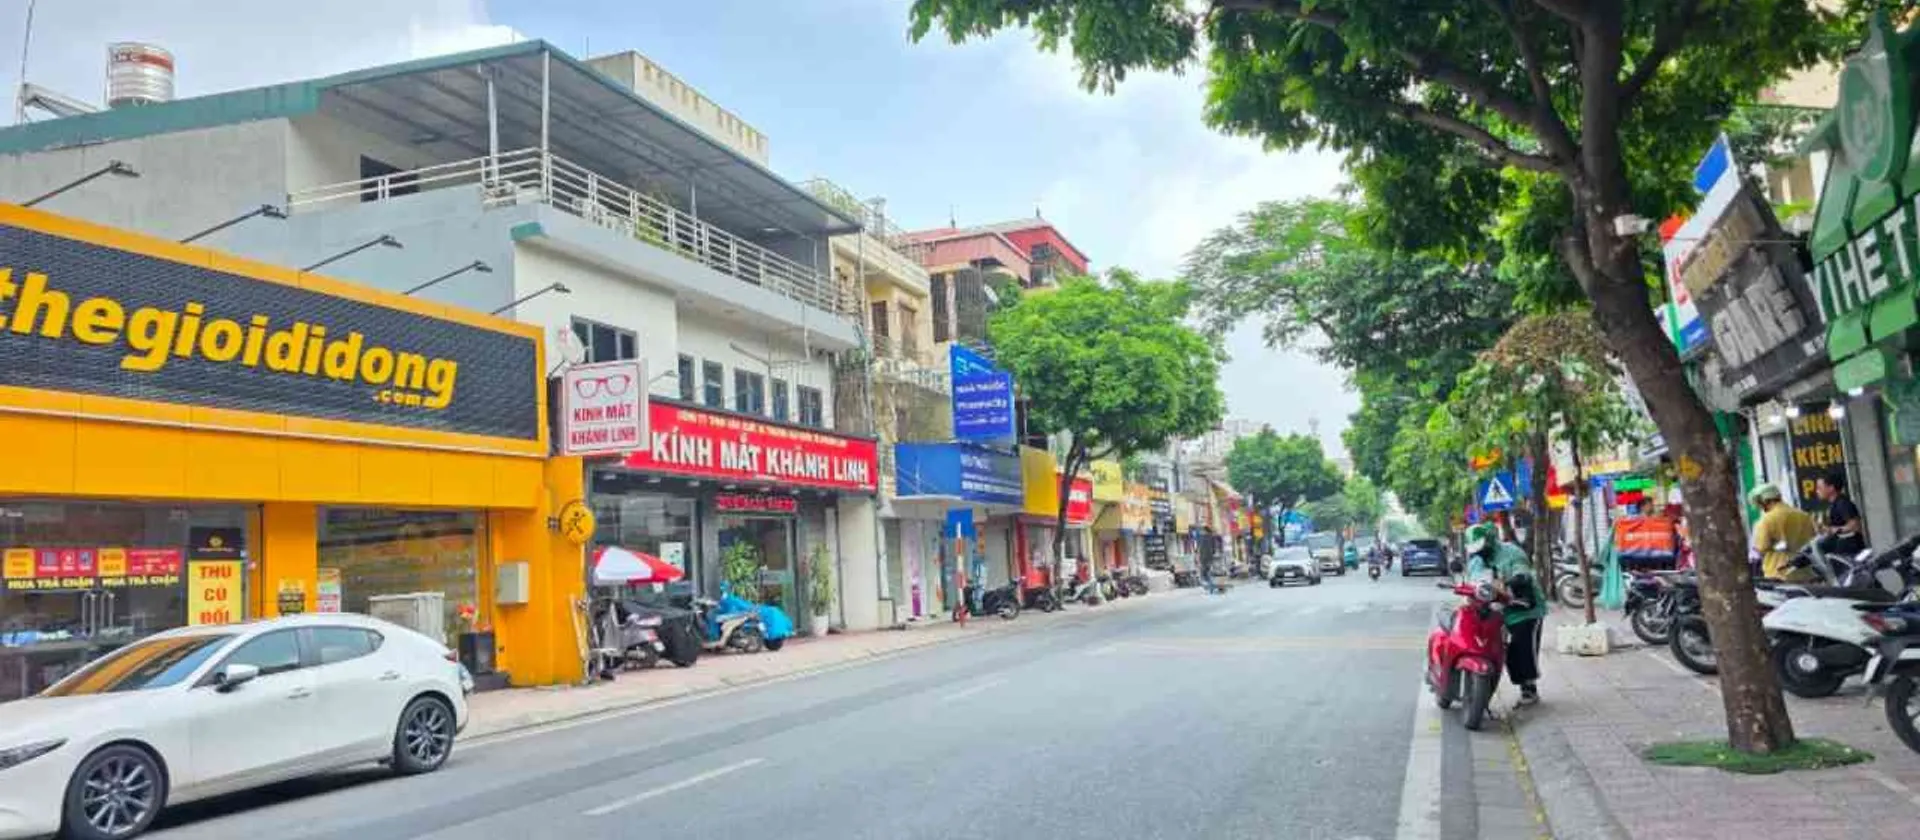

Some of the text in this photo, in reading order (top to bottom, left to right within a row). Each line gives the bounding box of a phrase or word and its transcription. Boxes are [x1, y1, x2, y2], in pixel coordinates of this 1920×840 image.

[612, 427, 637, 442] LINH
[652, 425, 713, 467] KÍNH
[720, 432, 761, 473] MẮT
[766, 446, 829, 479] KHÁNH
[834, 455, 869, 483] LINH
[1795, 442, 1843, 468] KIỆN
[199, 564, 232, 578] THU
